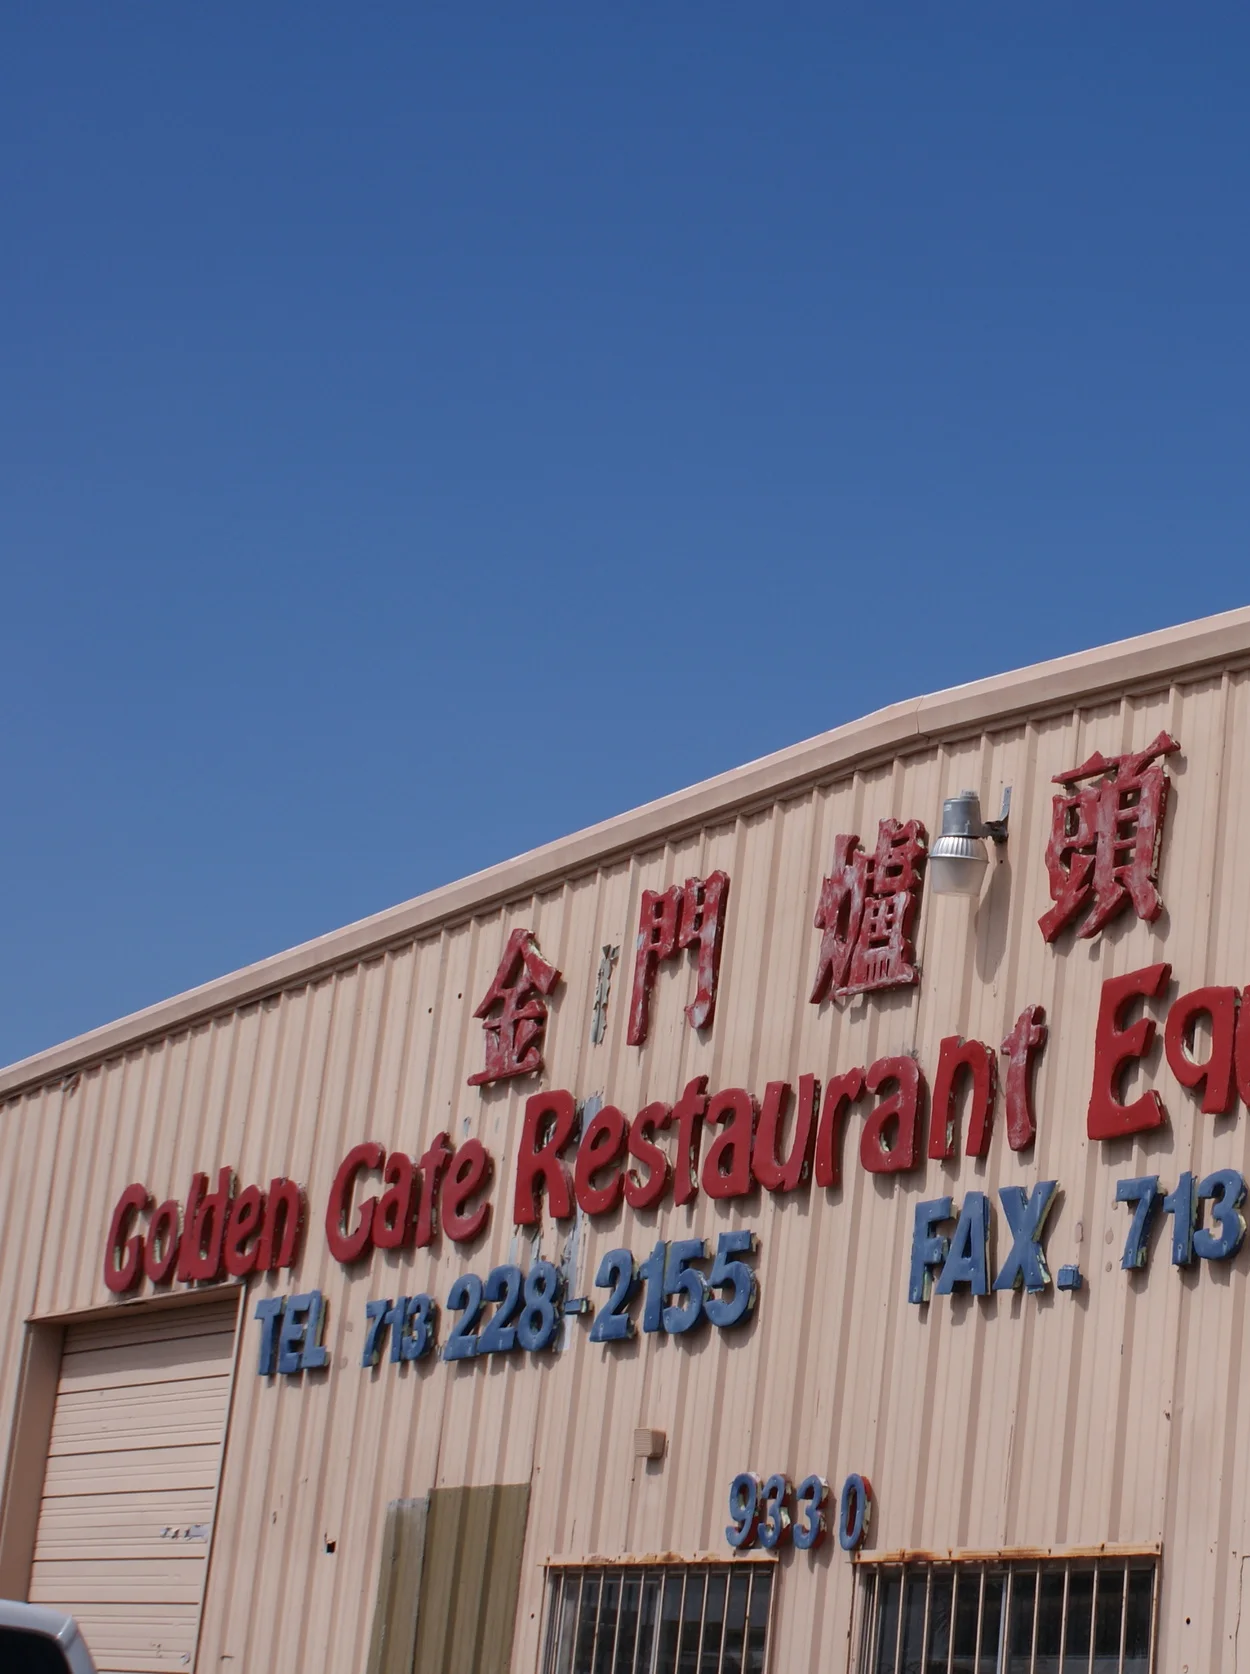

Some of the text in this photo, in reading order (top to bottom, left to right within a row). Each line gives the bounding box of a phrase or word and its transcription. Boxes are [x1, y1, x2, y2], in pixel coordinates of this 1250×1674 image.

[104, 1166, 308, 1293] Golden
[325, 1131, 493, 1264] Gate
[513, 1005, 1048, 1226] Restaurant
[908, 1180, 1082, 1304] FAX.
[1116, 1168, 1247, 1270] 713
[254, 1290, 330, 1376] TEL
[361, 1293, 438, 1369] 713
[725, 1472, 873, 1551] 9330
